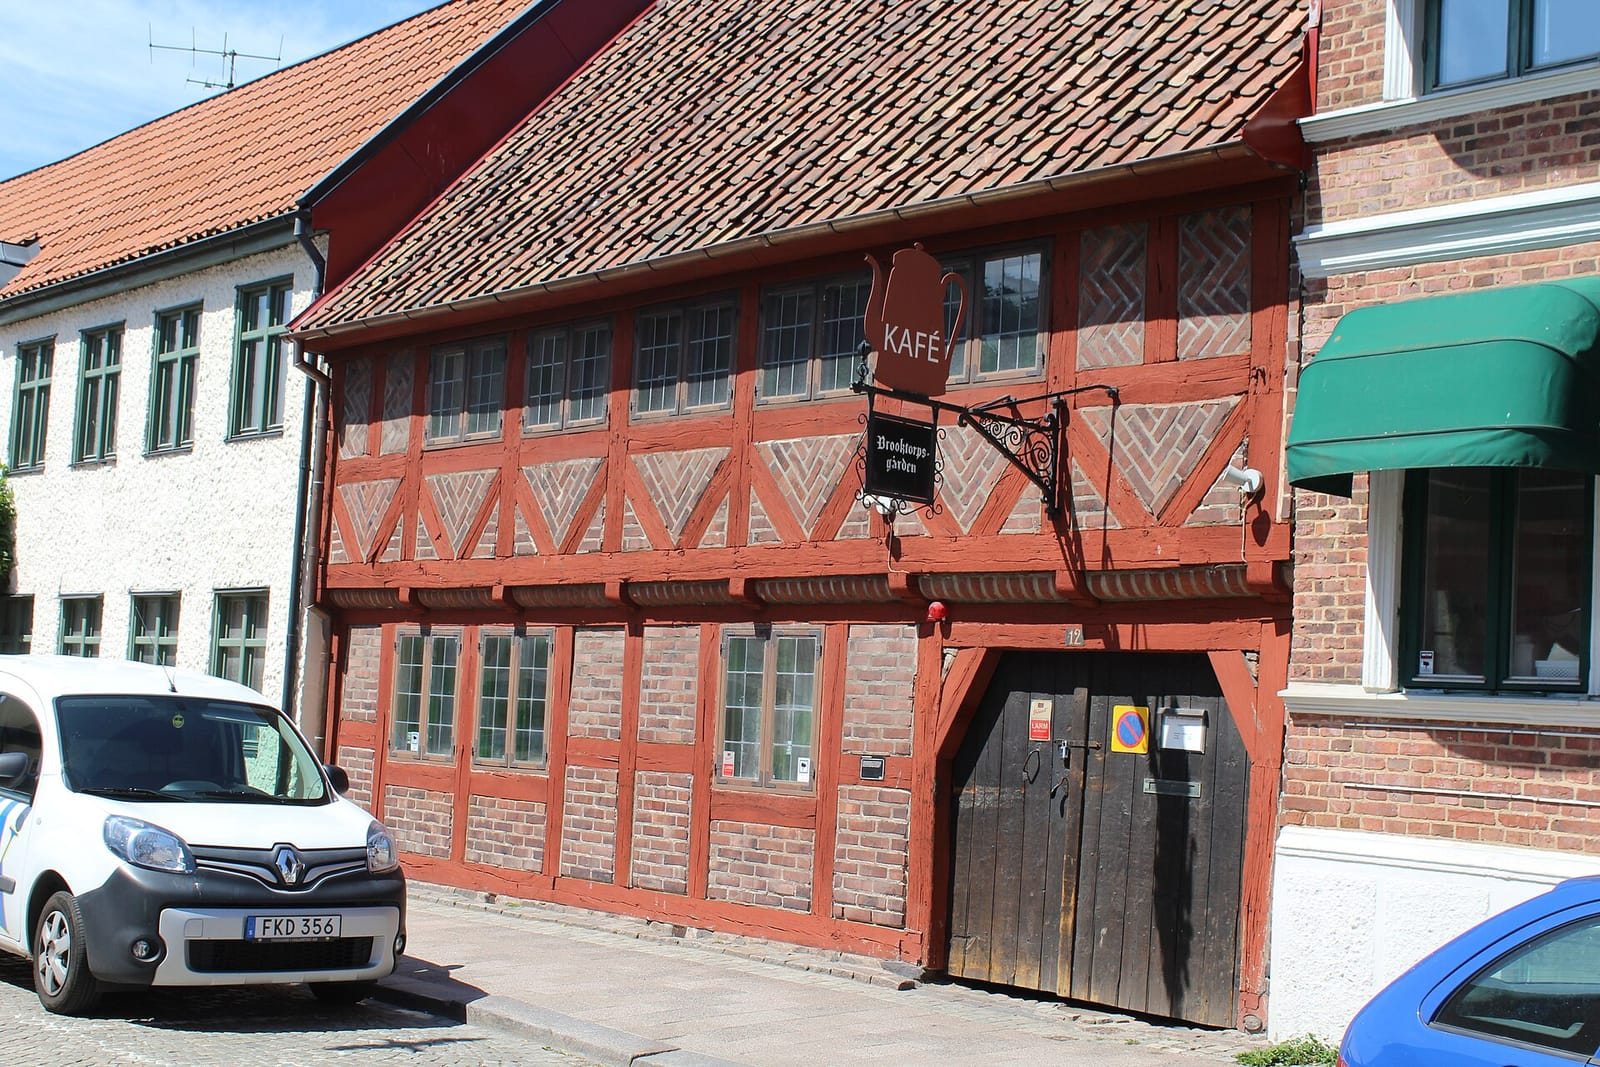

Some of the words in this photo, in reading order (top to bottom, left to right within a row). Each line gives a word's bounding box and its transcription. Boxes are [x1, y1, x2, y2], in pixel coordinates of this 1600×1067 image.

[884, 323, 940, 363] KAFÉ
[886, 455, 917, 473] gården
[1069, 628, 1081, 645] 12
[262, 918, 295, 936] FKD
[300, 918, 334, 935] 356
